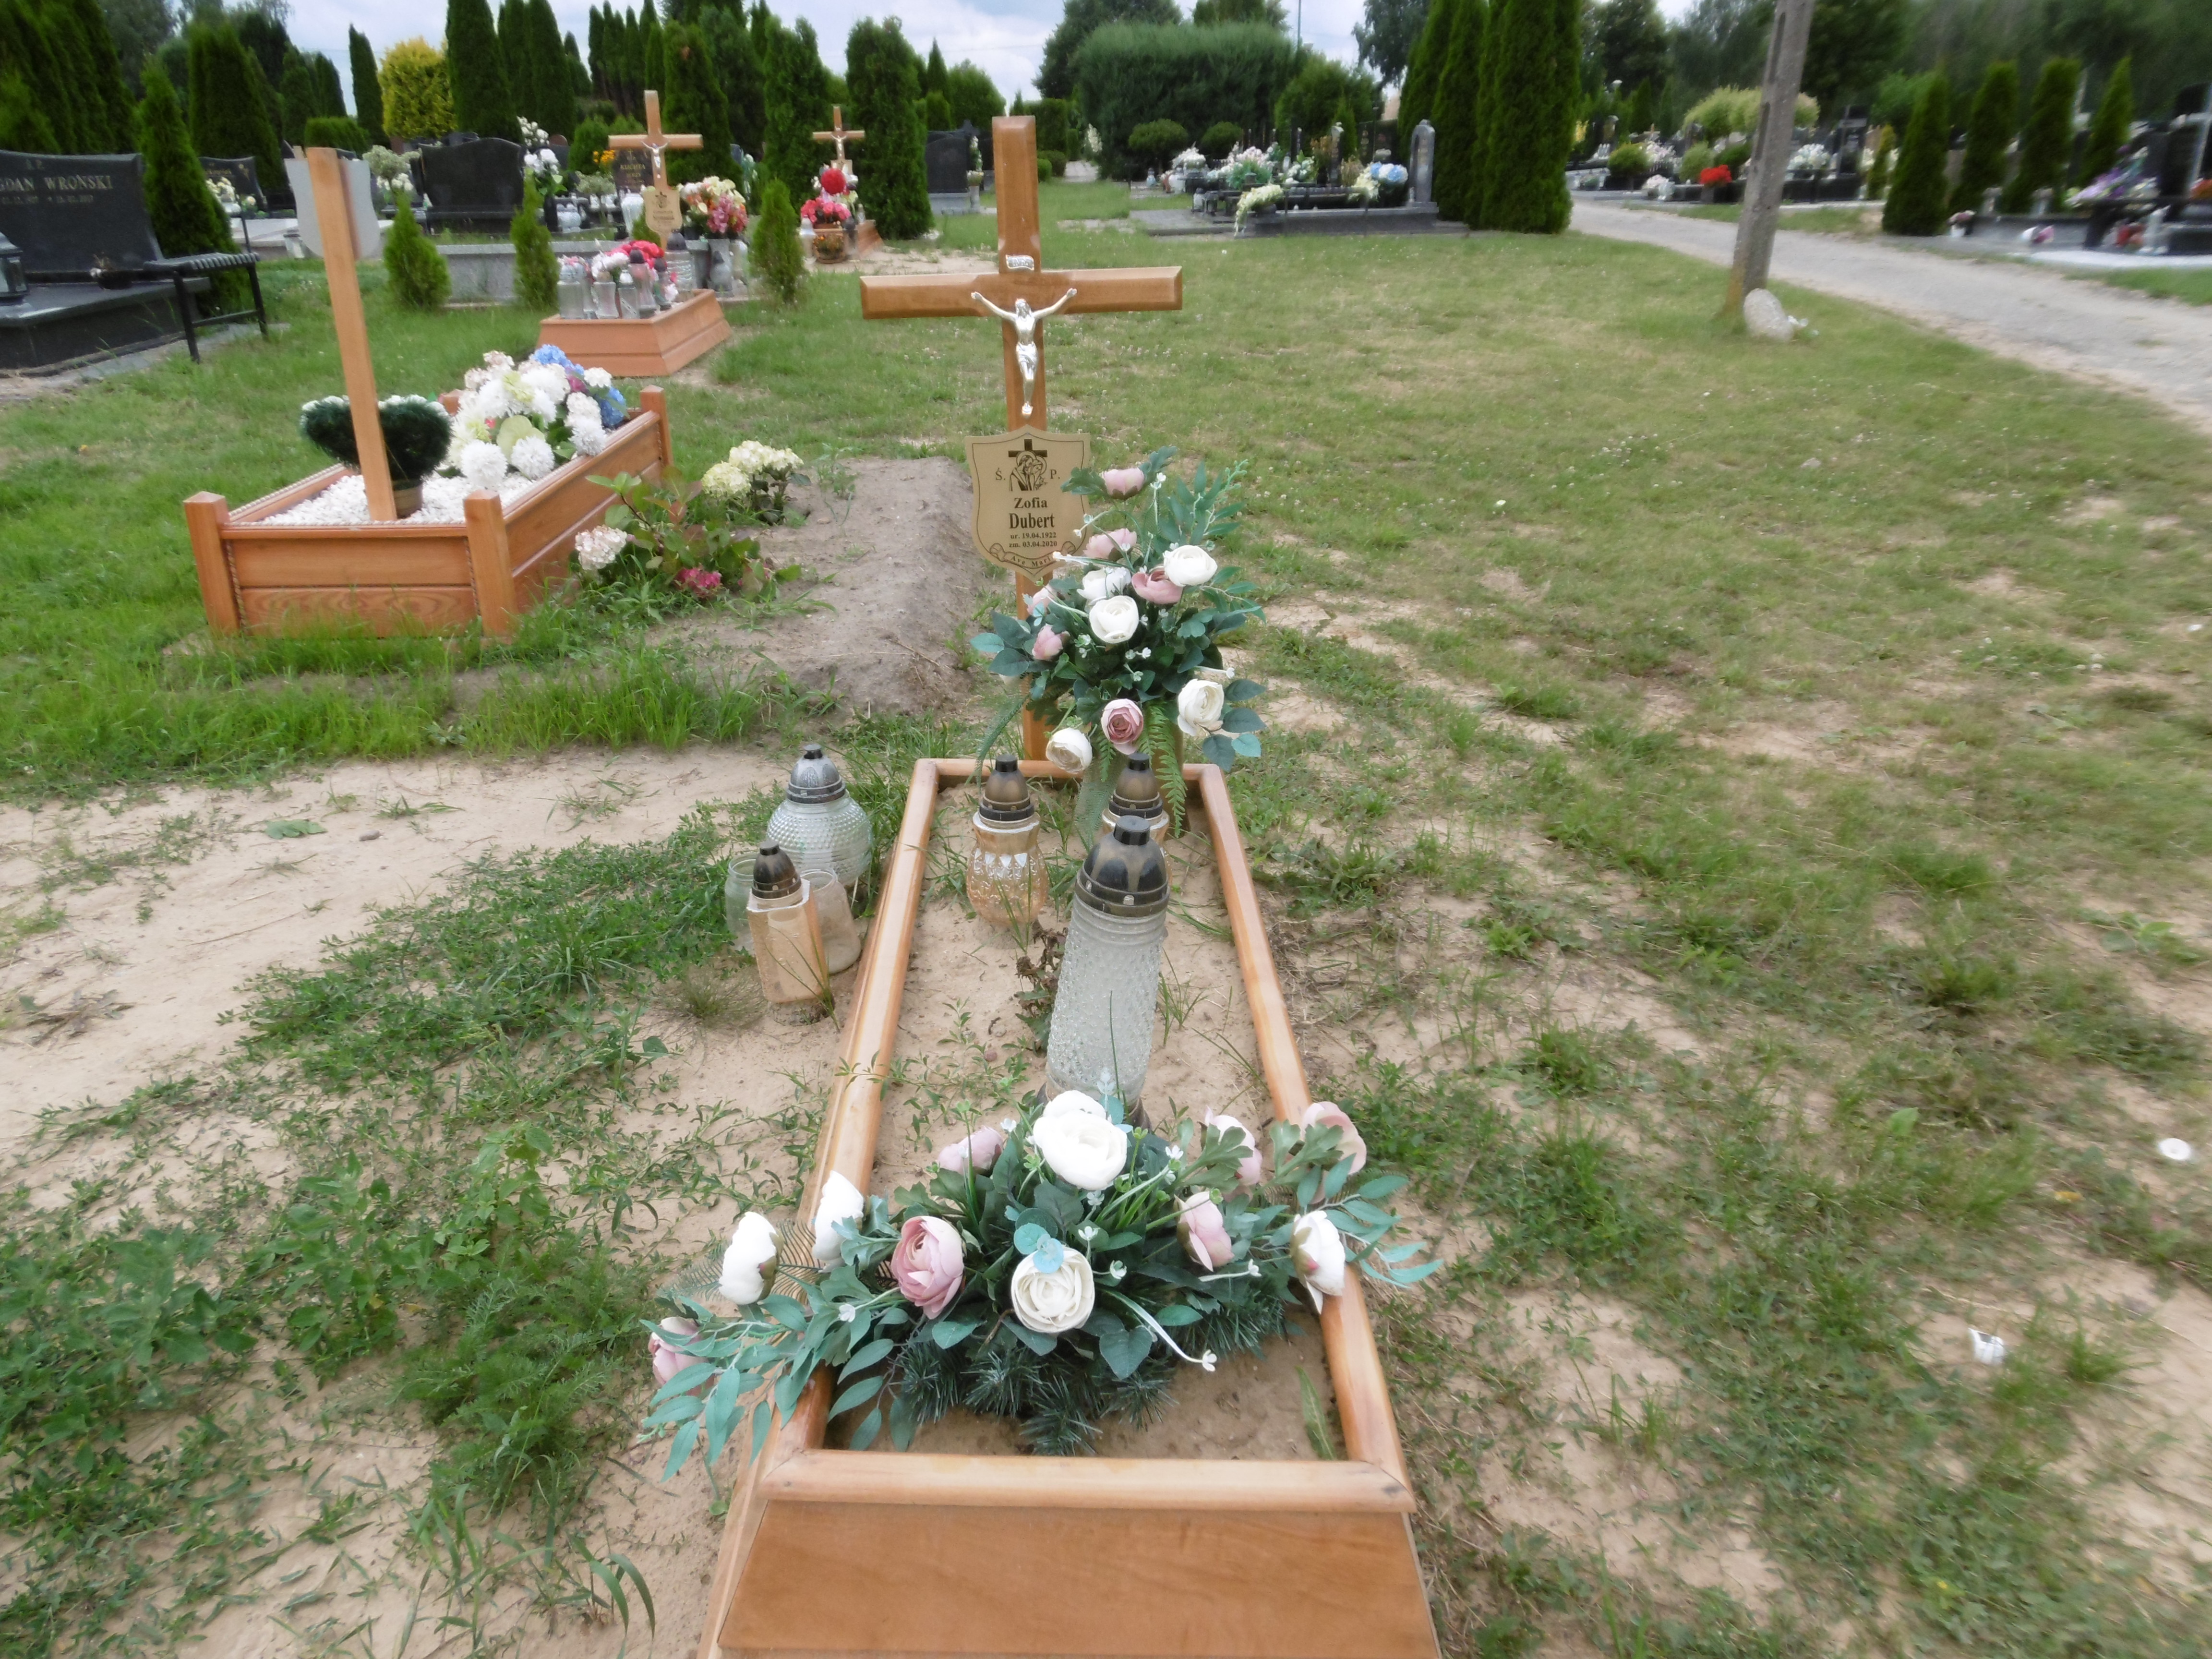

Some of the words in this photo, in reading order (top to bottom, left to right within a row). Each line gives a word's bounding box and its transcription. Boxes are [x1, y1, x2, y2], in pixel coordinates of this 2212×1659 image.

[995, 468, 1006, 481] Ś.
[1050, 469, 1060, 480] P.
[1014, 497, 1048, 509] Zofia
[1009, 513, 1056, 529] Dubert
[1010, 555, 1026, 565] Ave
[1032, 555, 1054, 566] Mari
